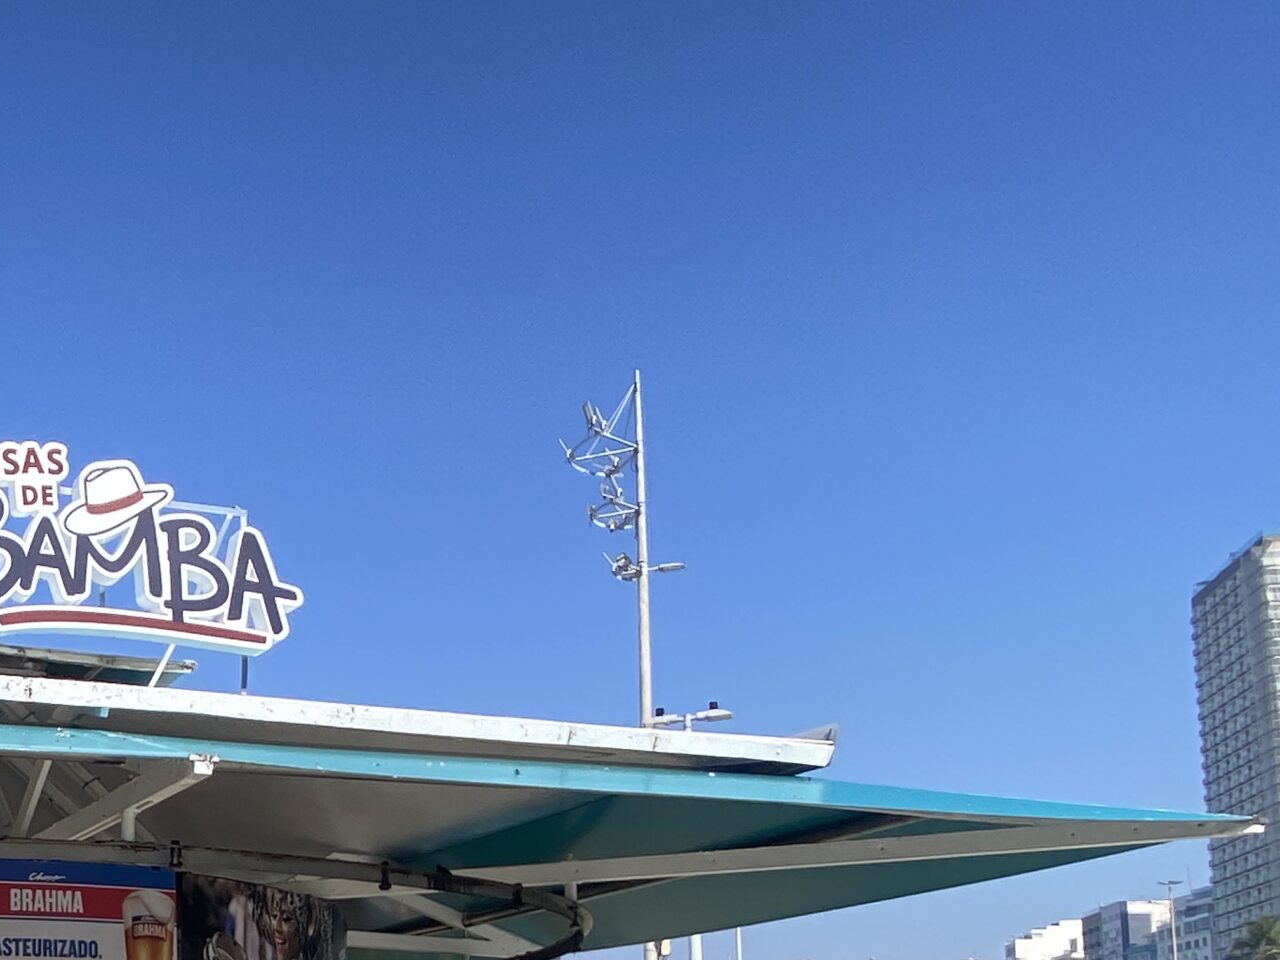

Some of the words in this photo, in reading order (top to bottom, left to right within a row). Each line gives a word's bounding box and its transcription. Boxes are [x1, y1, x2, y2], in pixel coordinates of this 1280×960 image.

[22, 485, 54, 507] DE
[9, 888, 84, 914] BRAHMA
[132, 922, 167, 940] BRAHMA
